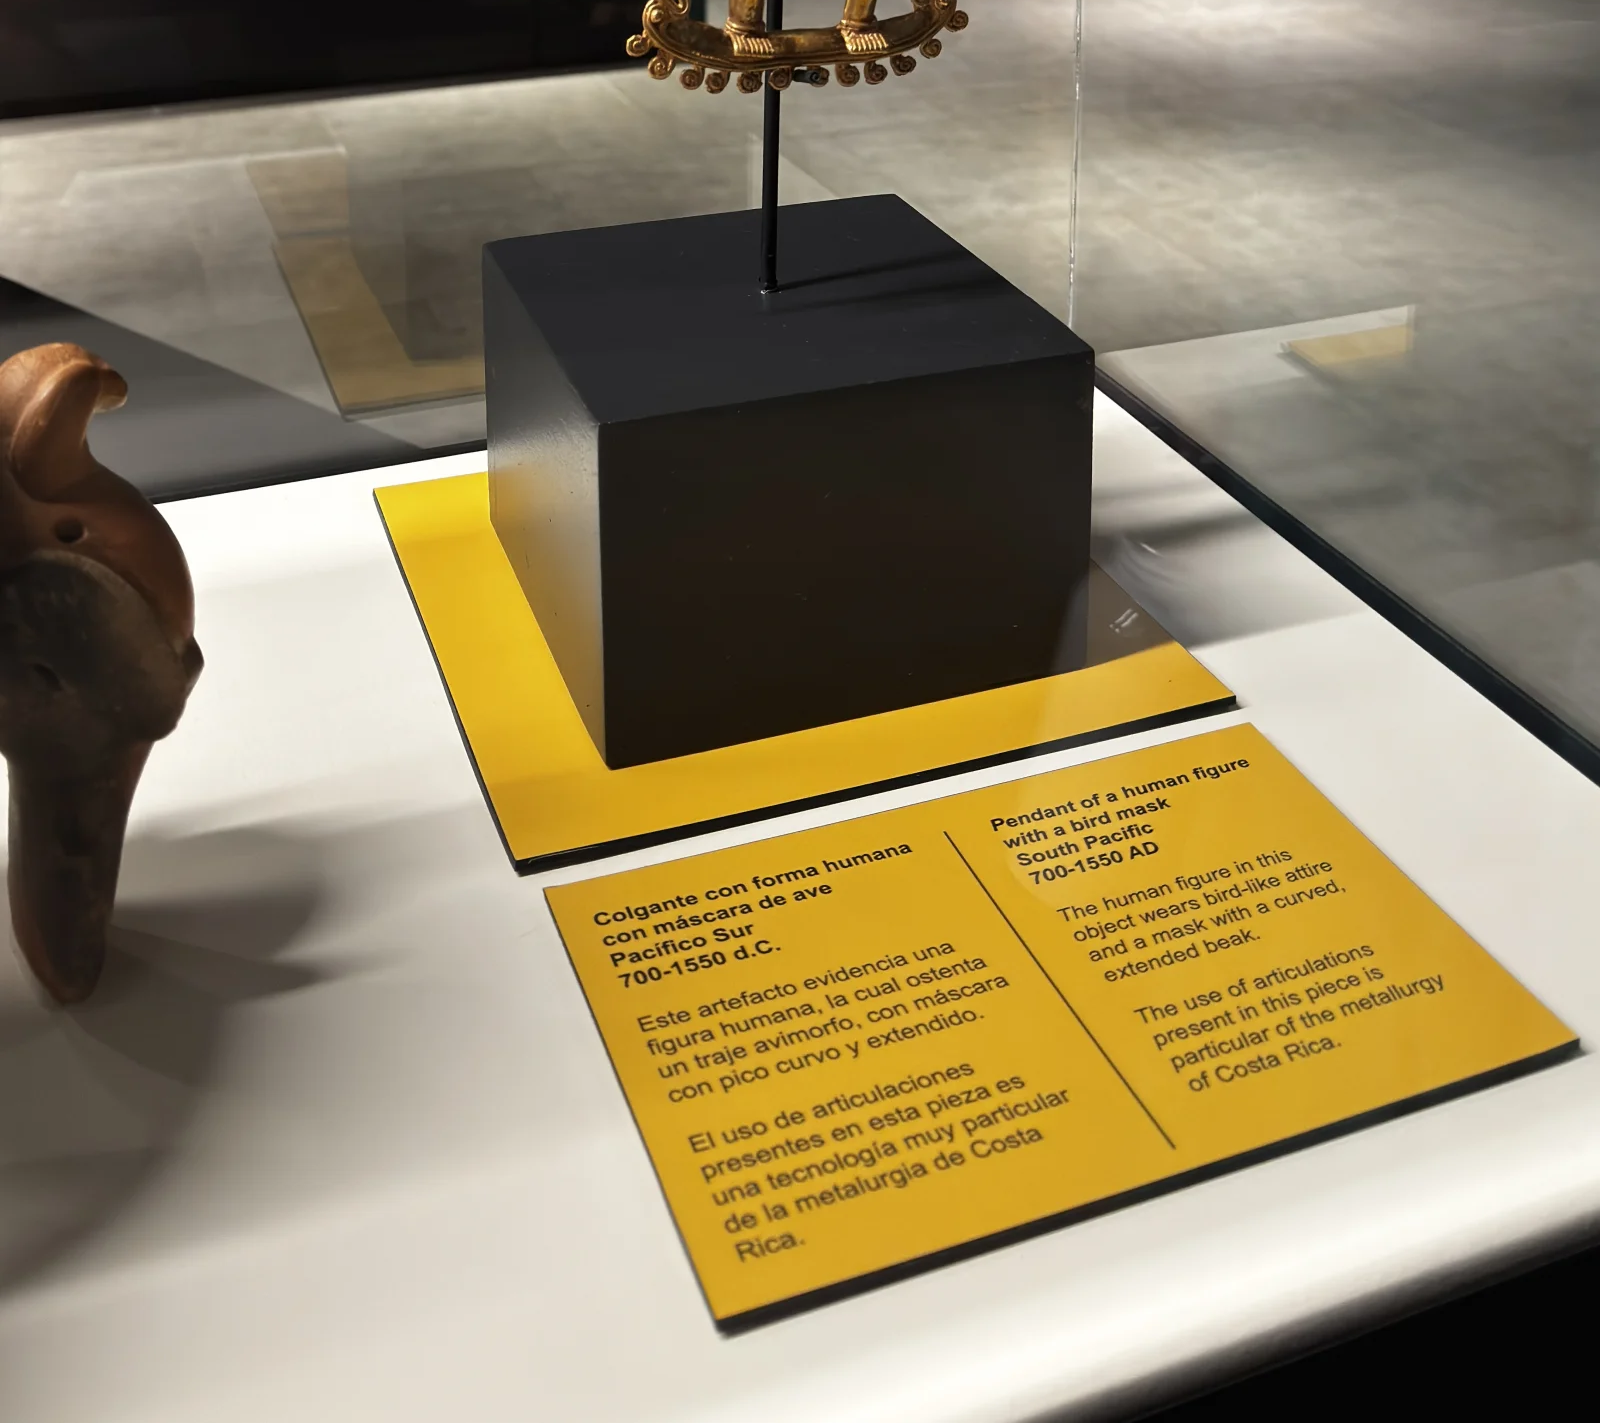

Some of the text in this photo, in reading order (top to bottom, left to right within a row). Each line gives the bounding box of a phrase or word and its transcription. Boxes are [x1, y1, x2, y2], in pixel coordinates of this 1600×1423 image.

[989, 758, 1251, 832] Pendant of a human figure
[1002, 797, 1172, 849] with a bird mask
[593, 843, 914, 926] Colgante con forma humana
[1016, 823, 1155, 867] South Pacific
[1027, 841, 1160, 885] 700-1550 AD
[602, 884, 833, 947] con máscara de ave
[1055, 849, 1293, 923] The human figure in this
[1073, 861, 1333, 942] object wears bird-like attire
[1088, 878, 1346, 963] and a mask with a curved,
[609, 923, 755, 968] Pacífico Sur
[617, 939, 782, 989] 700-1550 d.C.
[1103, 928, 1261, 983] extended beak.
[1132, 945, 1375, 1024] The use of articulations
[636, 942, 957, 1033] Este artefacto evidencia una
[646, 957, 988, 1056] figura humana, la cual ostenta
[657, 976, 1011, 1079] un traje avimorfo, con máscara
[1152, 966, 1385, 1052] present in this piece is
[1169, 974, 1444, 1074] particular of the metallurgy
[668, 1009, 985, 1103] con pico curvo y extendido.
[1188, 1037, 1342, 1092] of Costa Rica.
[687, 1063, 975, 1154] El uso de articulaciones
[700, 1076, 1026, 1184] presentes en esta pieza es
[711, 1089, 1070, 1207] una tecnología muy particular
[724, 1128, 1044, 1234] de la metalurgia de Costa
[734, 1232, 804, 1263] Rica.
